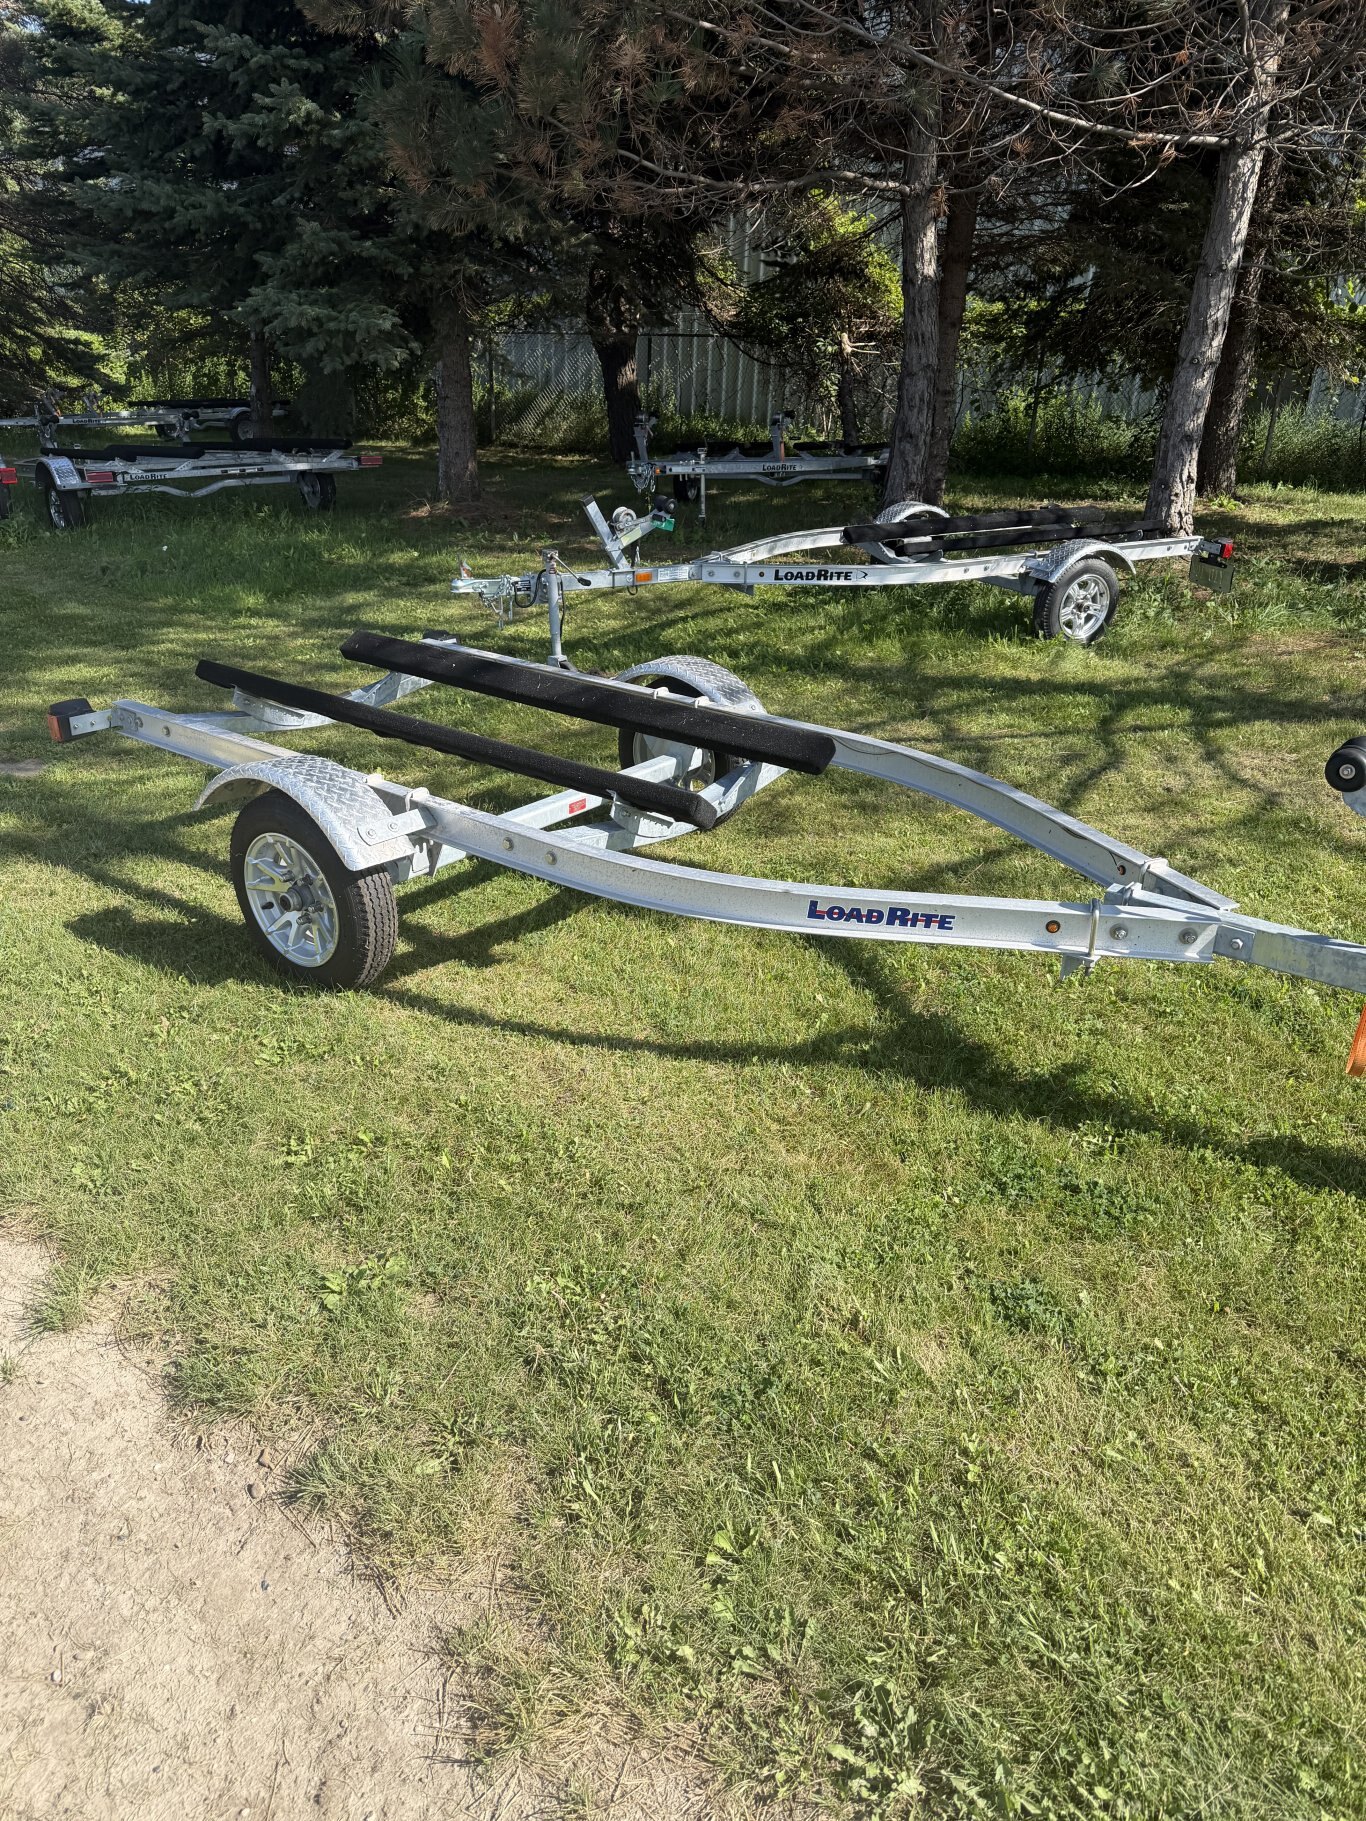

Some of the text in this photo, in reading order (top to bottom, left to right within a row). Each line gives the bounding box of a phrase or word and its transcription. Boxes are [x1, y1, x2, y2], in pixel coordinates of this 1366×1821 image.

[762, 463, 797, 471] LOADRITE
[774, 569, 853, 581] LOADRITE
[807, 900, 956, 931] LOADRITE
